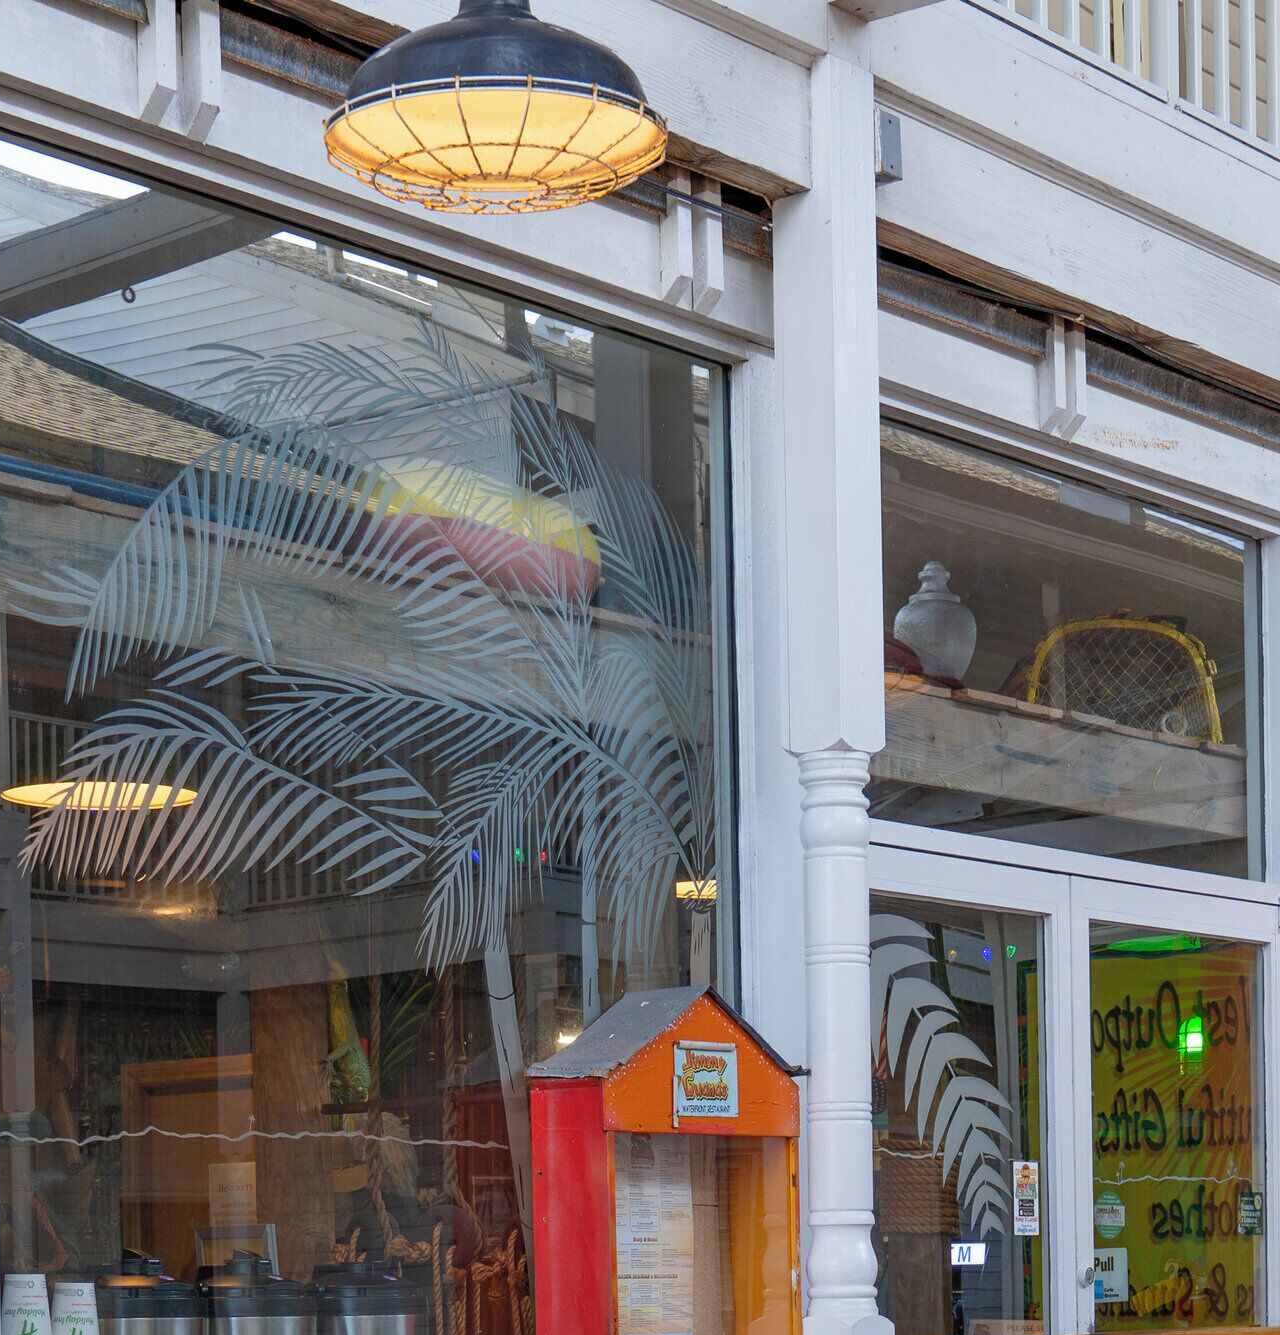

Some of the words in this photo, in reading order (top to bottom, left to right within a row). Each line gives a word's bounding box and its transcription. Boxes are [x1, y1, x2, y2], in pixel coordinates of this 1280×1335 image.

[682, 1050, 727, 1076] Jimmy
[1094, 1256, 1114, 1272] Pull
[4, 1309, 16, 1317] Inn
[16, 1307, 46, 1318] Holiday
[65, 1315, 95, 1326] Holiday
